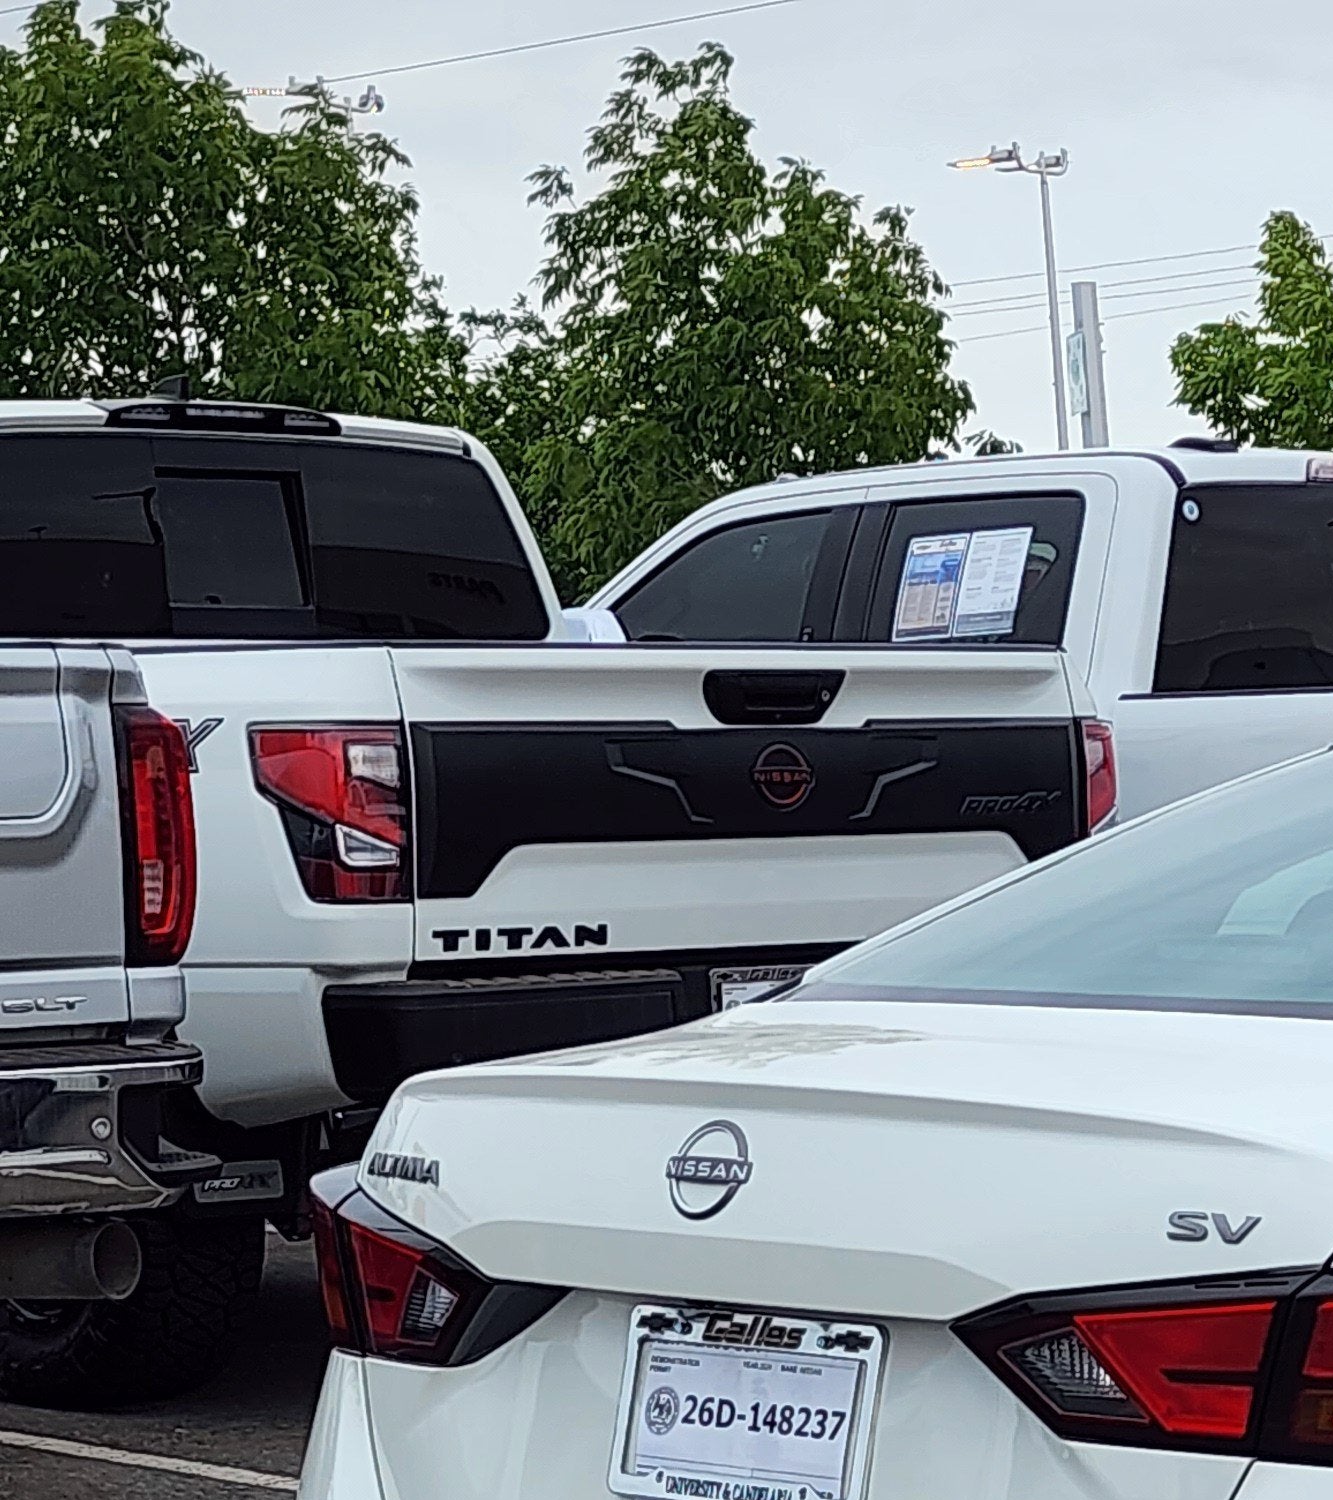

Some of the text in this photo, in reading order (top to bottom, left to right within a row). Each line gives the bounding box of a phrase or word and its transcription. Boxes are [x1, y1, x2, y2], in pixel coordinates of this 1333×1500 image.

[754, 771, 811, 783] NISSAN
[432, 924, 607, 952] TITAN
[1, 996, 88, 1013] SLT
[367, 1152, 440, 1186] ALTIMA
[667, 1160, 748, 1180] NISSAN
[1166, 1211, 1262, 1245] SV
[681, 1394, 847, 1441] 26D-148237
[665, 1475, 723, 1500] UNIVERSITY
